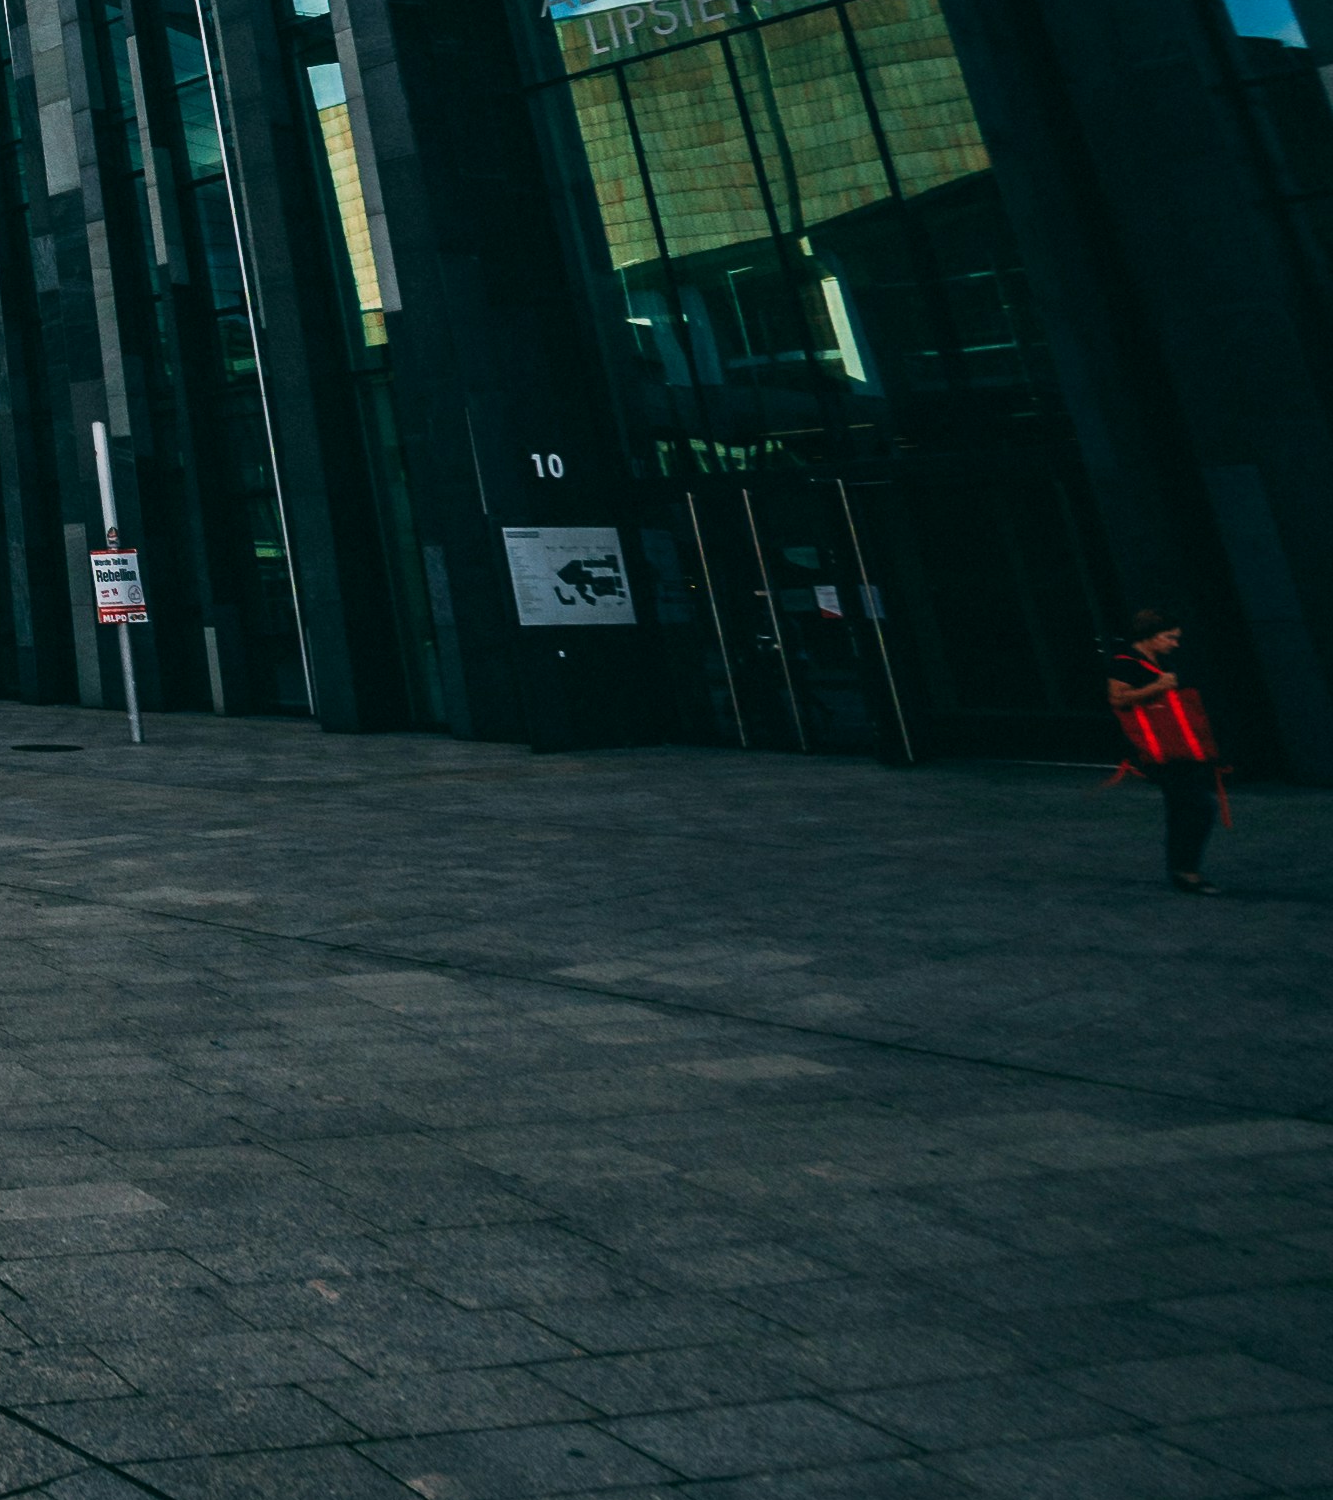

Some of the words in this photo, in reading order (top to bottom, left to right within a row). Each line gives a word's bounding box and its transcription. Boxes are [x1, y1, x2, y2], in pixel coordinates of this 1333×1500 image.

[531, 454, 564, 477] 10
[96, 569, 136, 582] Rebellion
[103, 614, 126, 622] MLPD
